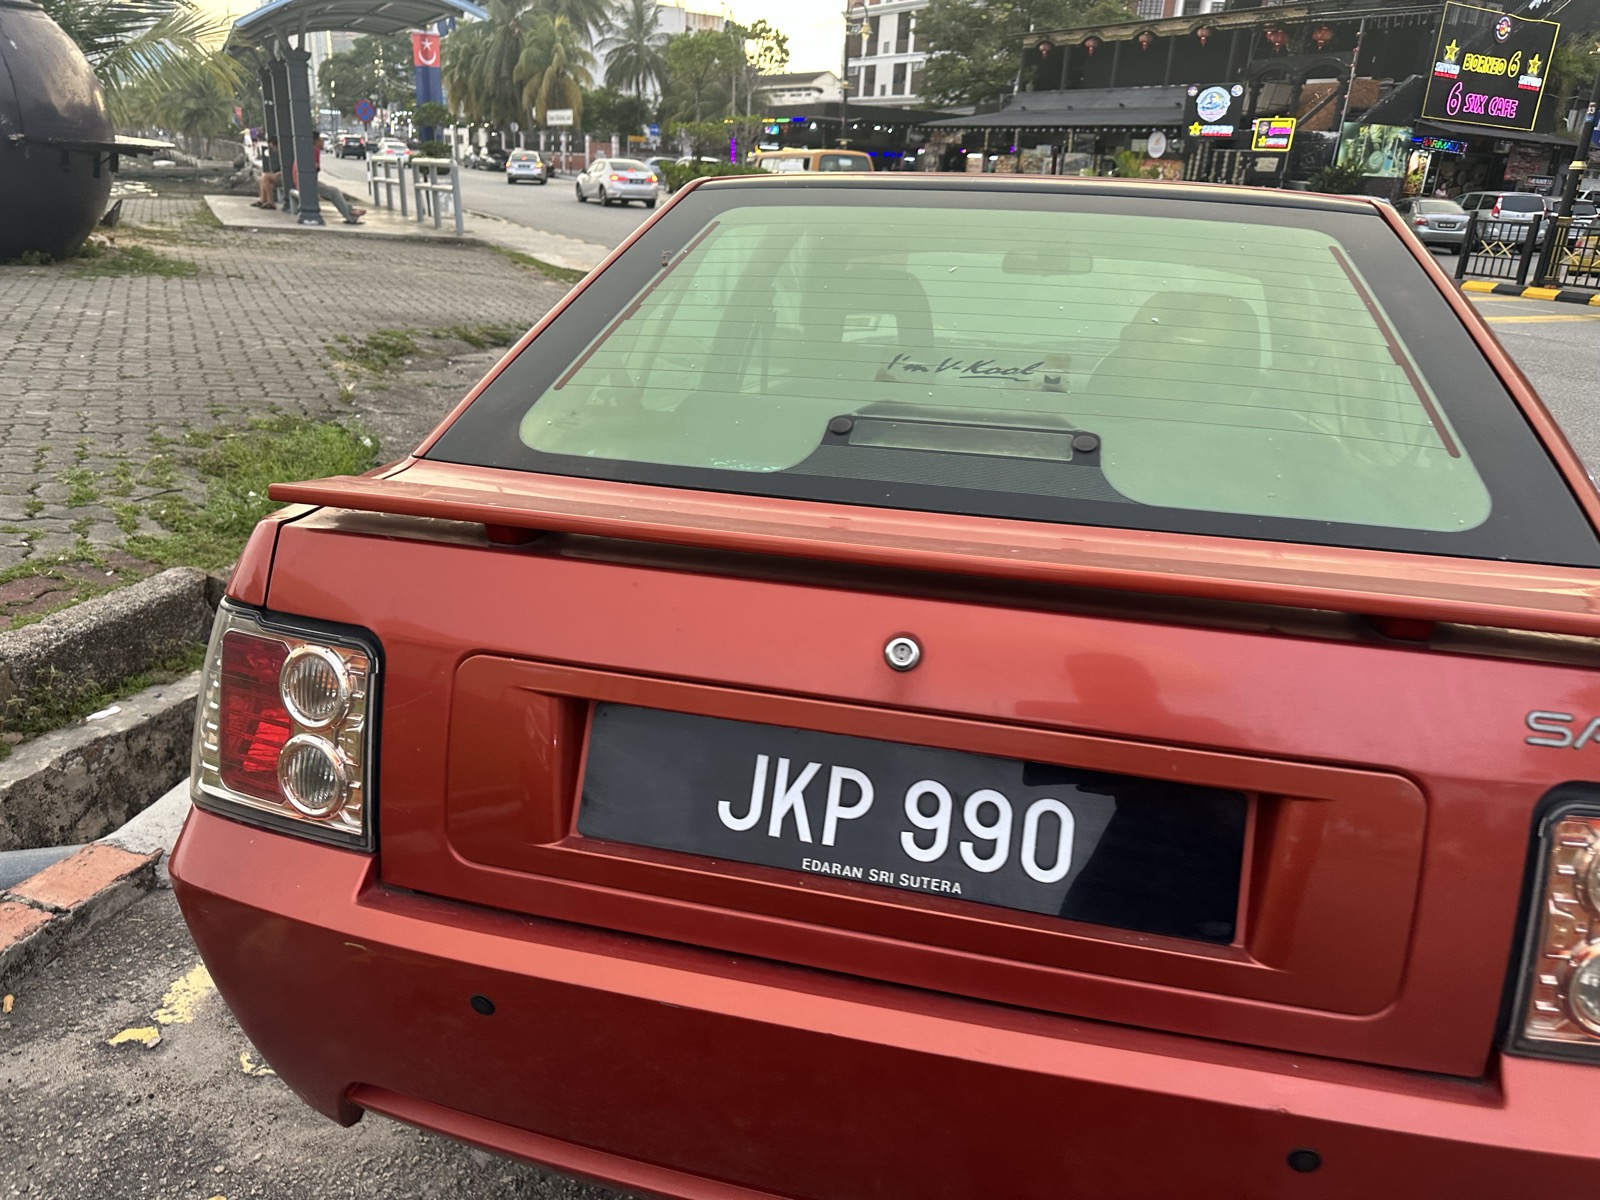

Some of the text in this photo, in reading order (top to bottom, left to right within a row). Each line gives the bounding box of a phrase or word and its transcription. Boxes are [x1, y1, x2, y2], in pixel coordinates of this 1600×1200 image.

[1462, 51, 1522, 78] BORNEO 6
[1446, 81, 1518, 118] 6 SIX CAFE
[887, 353, 930, 372] I'm
[717, 753, 1075, 884] JKP 990
[801, 857, 963, 895] EDARAN SRI SUTERA
